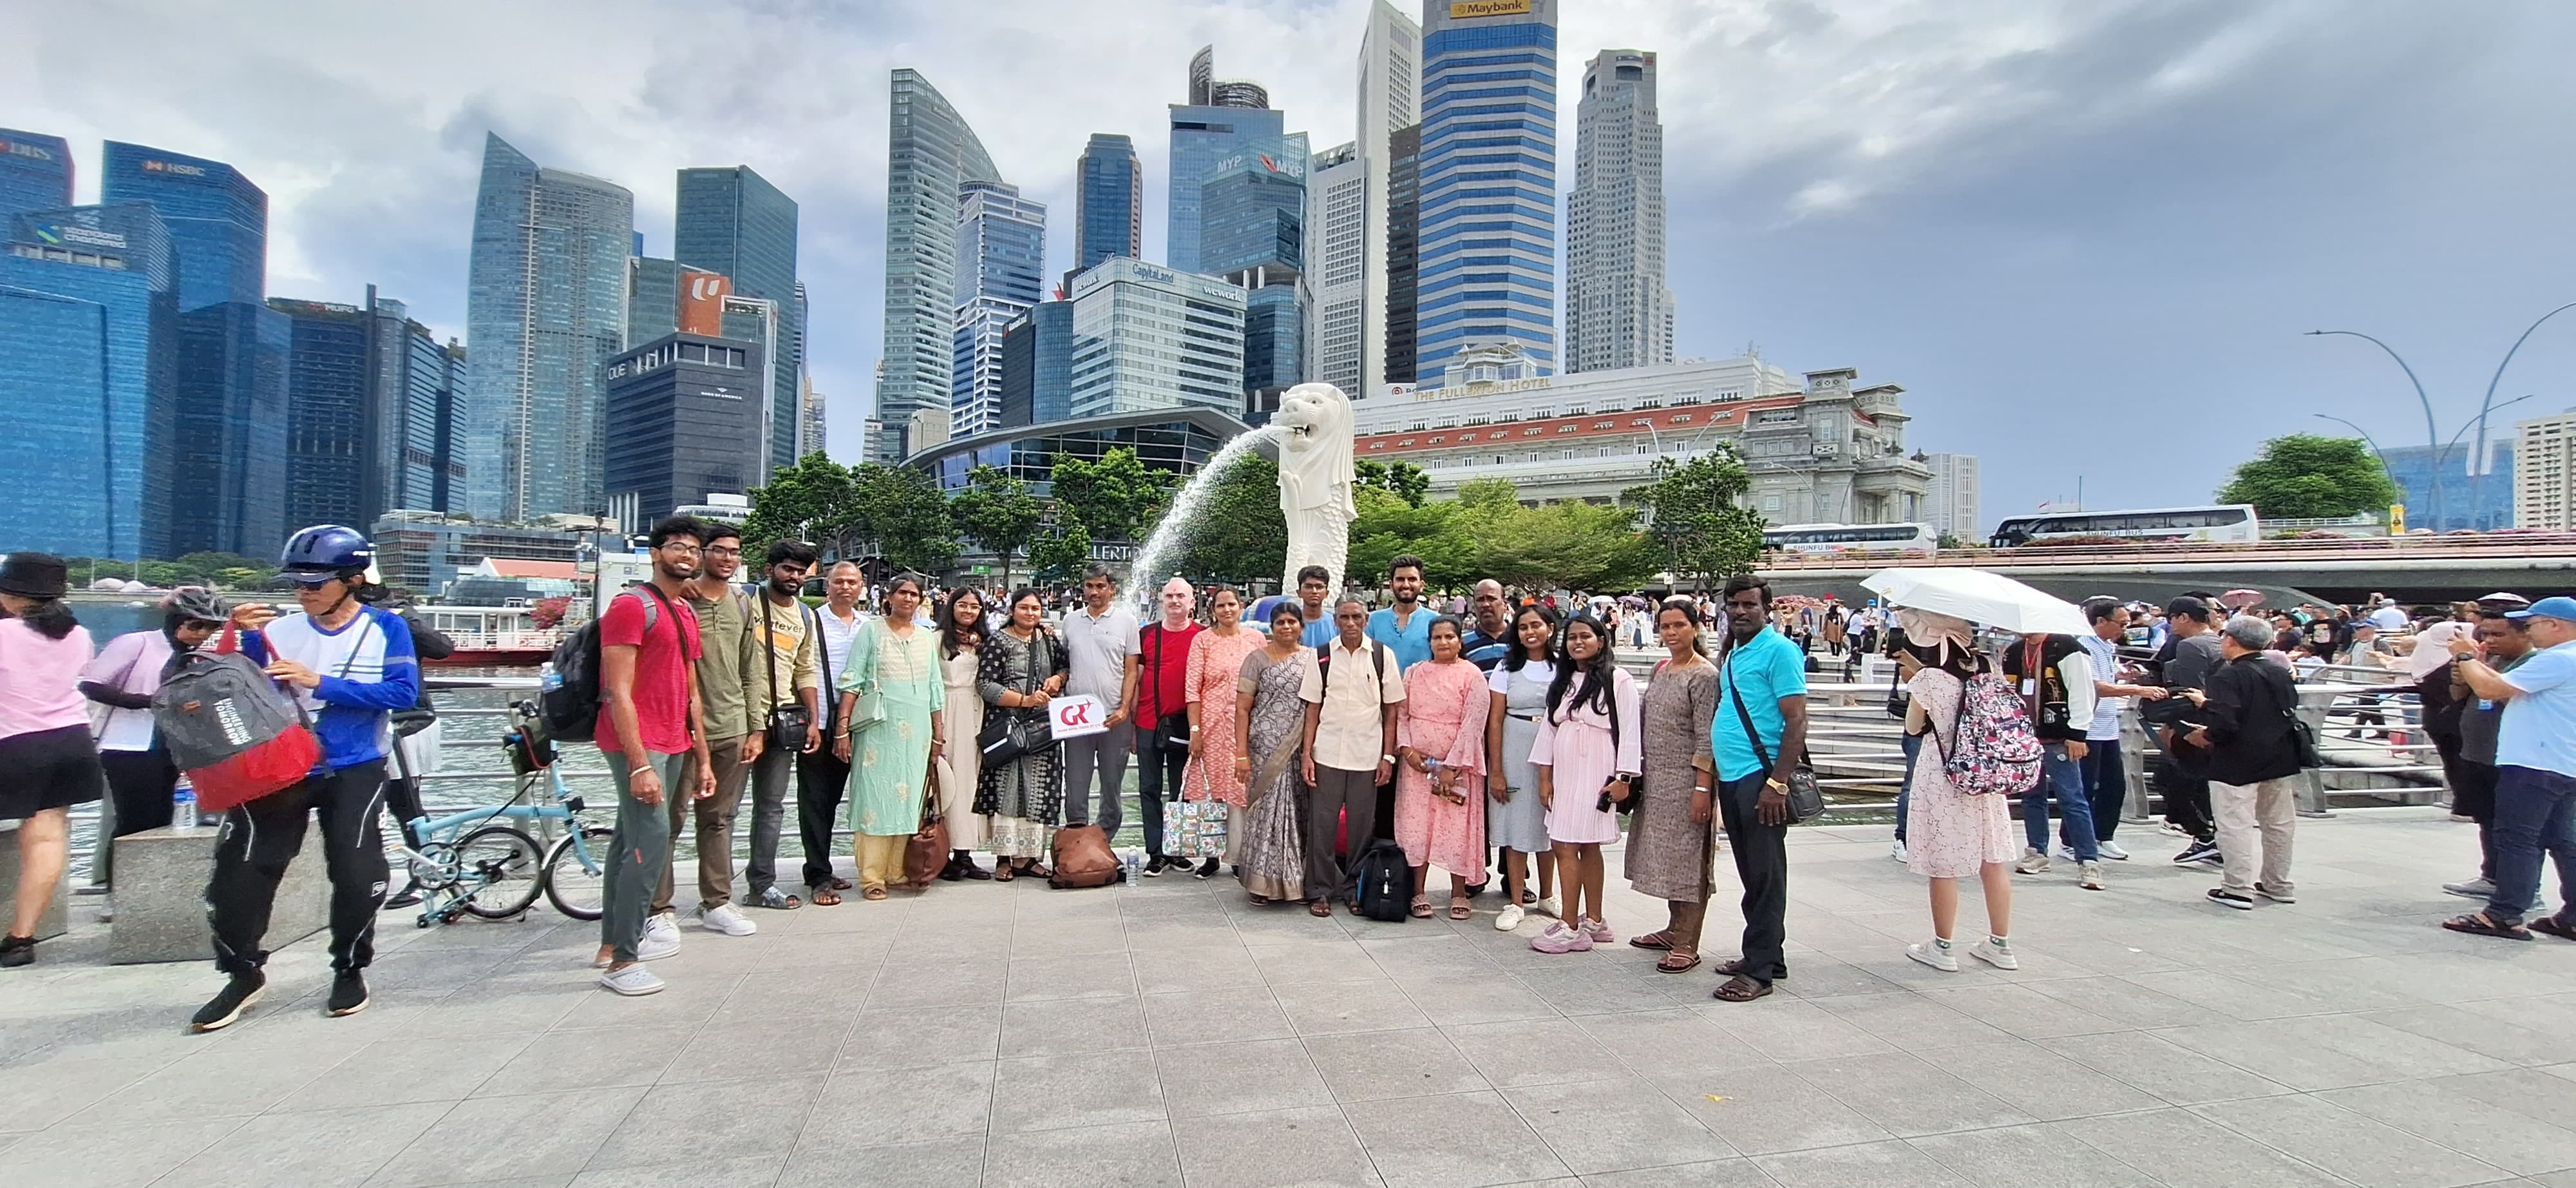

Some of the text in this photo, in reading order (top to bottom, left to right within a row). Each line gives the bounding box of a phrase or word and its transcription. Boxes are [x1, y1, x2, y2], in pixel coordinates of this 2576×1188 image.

[1467, 0, 1522, 14] Maybank
[167, 163, 207, 176] HSBC
[1218, 155, 1242, 173] MYP
[1276, 160, 1304, 178] MYP
[1133, 263, 1174, 283] CapitaLand
[1204, 287, 1242, 302] wework
[608, 363, 627, 380] OUE
[1415, 377, 1551, 401] THE FULLERTON HOTEL
[212, 699, 244, 745] TOMORROW
[223, 698, 252, 743] ENGINEERING
